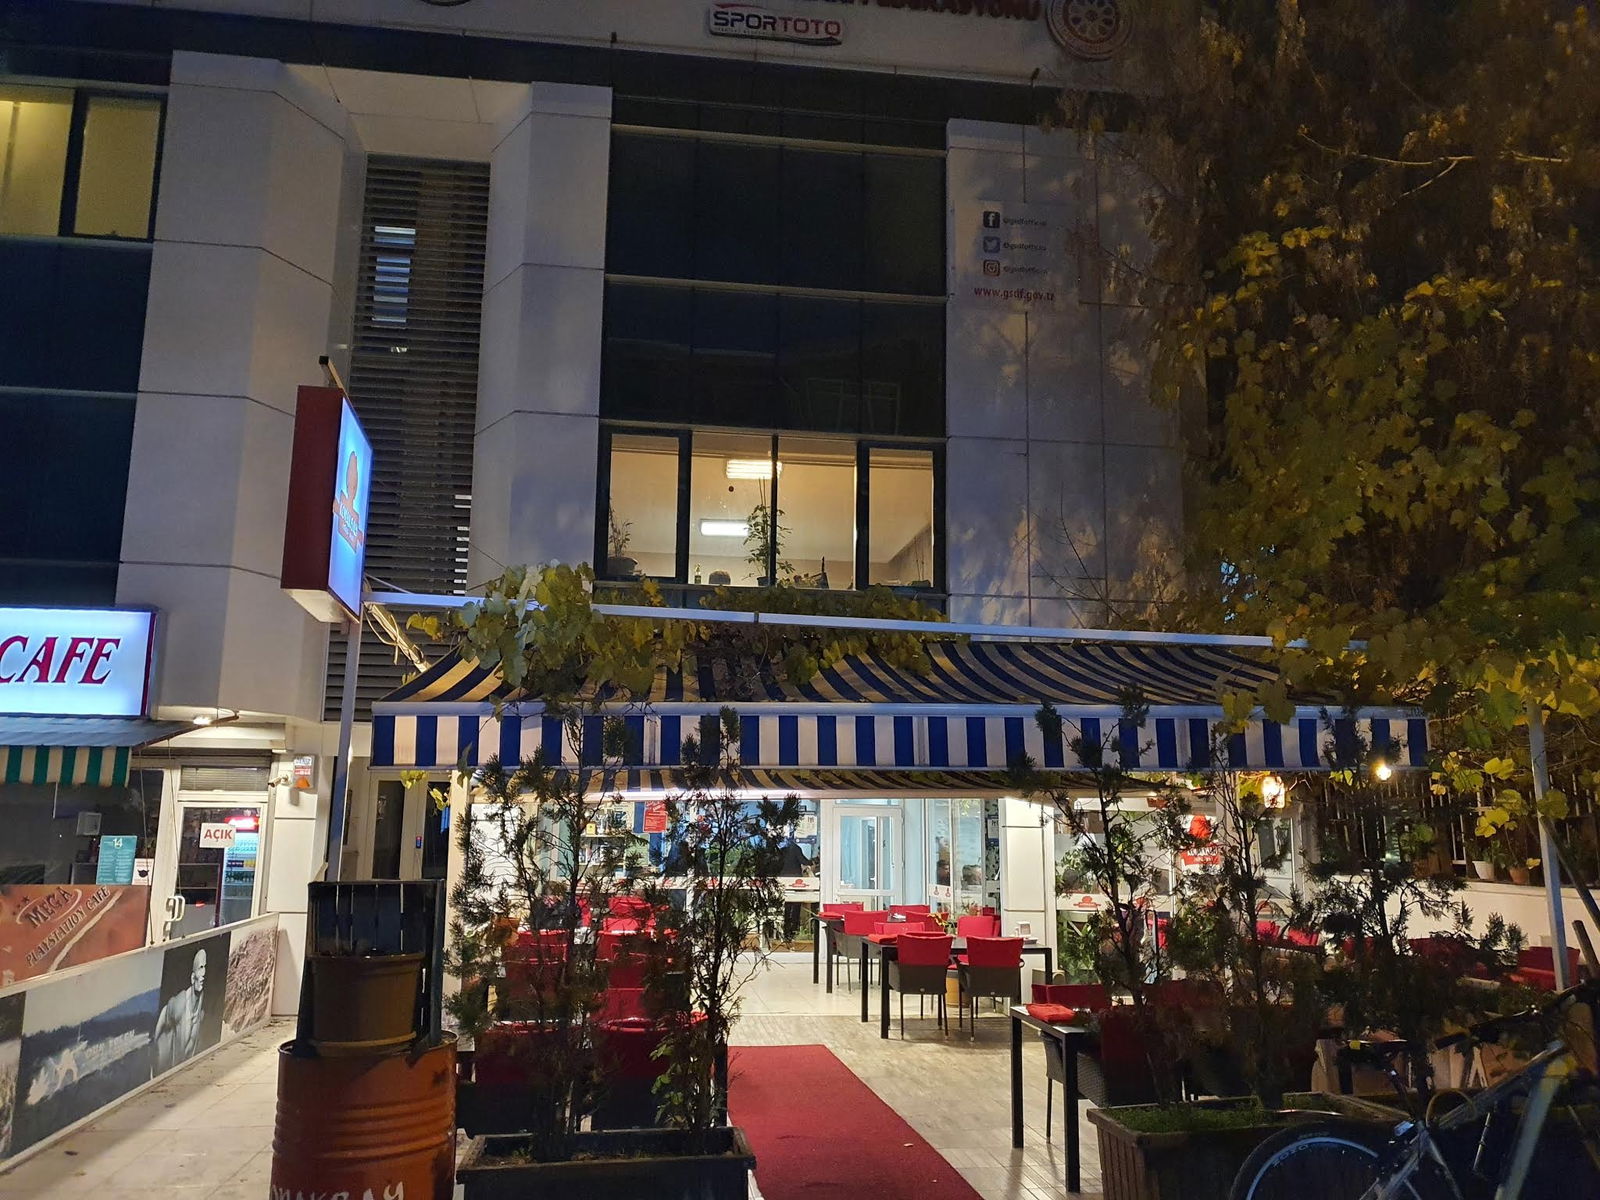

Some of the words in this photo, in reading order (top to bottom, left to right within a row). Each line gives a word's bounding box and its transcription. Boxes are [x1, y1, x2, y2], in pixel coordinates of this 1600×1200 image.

[713, 11, 841, 36] SPORTOTO
[974, 287, 1054, 302] www.gsdf.gov.tr
[0, 635, 121, 685] CAFE
[203, 828, 233, 843] AÇIK
[25, 886, 72, 929] MEGA
[25, 906, 87, 968] PLAYSTATION
[86, 885, 111, 912] CAFE
